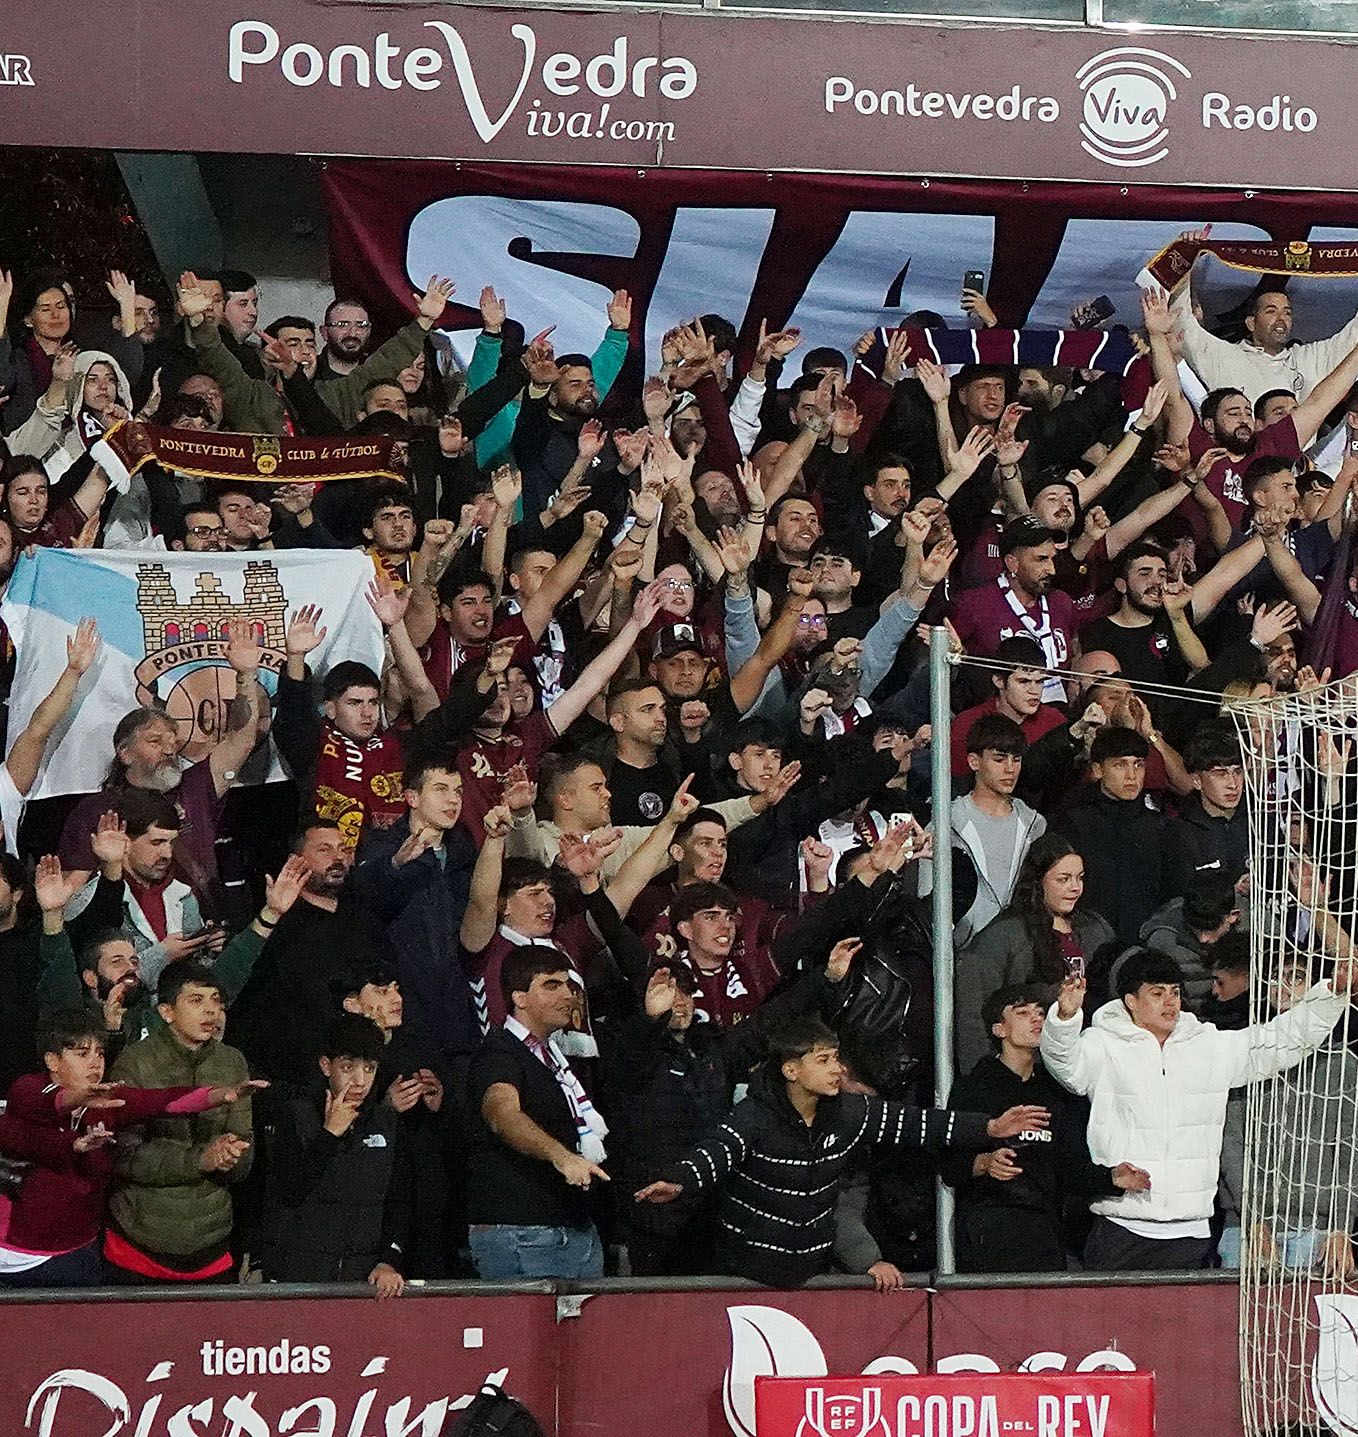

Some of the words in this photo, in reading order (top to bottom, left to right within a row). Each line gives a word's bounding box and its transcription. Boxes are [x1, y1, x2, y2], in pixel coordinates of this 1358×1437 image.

[825, 77, 1060, 122] Pontevedra
[1090, 87, 1163, 126] Viva
[1202, 92, 1319, 133] Radio
[159, 438, 245, 459] PONTEVEDRA
[287, 450, 316, 460] CLUB
[332, 442, 380, 459] FÚTBOL
[152, 642, 288, 671] PONTERA
[200, 1338, 332, 1376] tiendas
[897, 1396, 1000, 1437] COPA
[1003, 1420, 1034, 1431] DEL
[1038, 1395, 1110, 1437] REY
